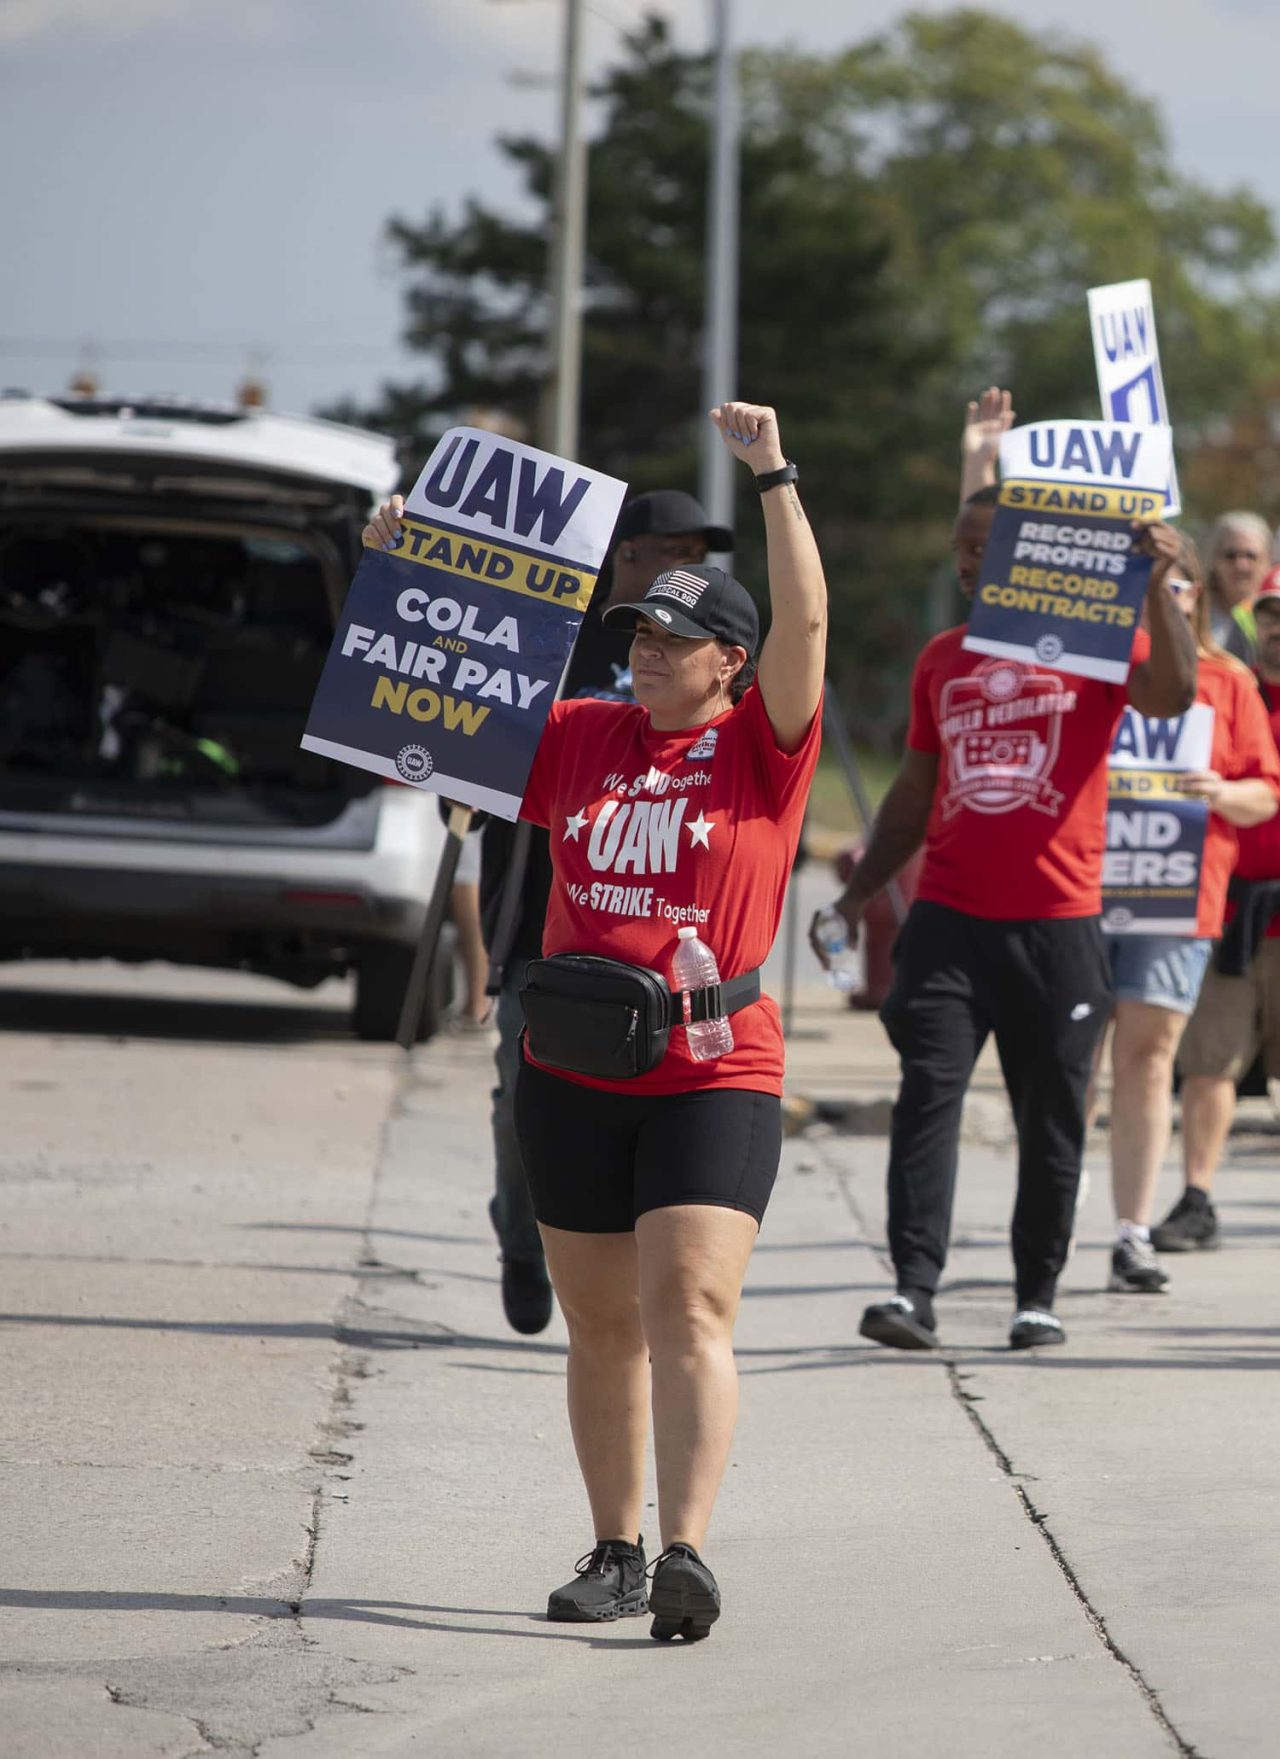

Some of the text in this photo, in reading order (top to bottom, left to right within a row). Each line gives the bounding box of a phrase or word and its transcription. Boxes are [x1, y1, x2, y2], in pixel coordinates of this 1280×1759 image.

[1029, 428, 1142, 478] UAW
[424, 435, 591, 546] UAW
[1010, 485, 1155, 516] STAND UP
[1019, 521, 1132, 551] RECORD
[1014, 541, 1126, 575] PROFITS
[524, 559, 581, 597] UP
[657, 586, 697, 606] LOCAL 900
[1009, 564, 1119, 600] RECORD
[396, 588, 520, 653] COLA
[980, 583, 1135, 627] CONTRACTS
[433, 635, 468, 654] AND
[341, 624, 550, 710] FAIR PAY
[371, 676, 491, 737] NOW
[1111, 711, 1185, 762] AW
[406, 756, 423, 769] UAW
[603, 773, 627, 795] We
[672, 770, 712, 791] ogethe
[587, 798, 688, 875] UAW
[1107, 810, 1182, 849] ND
[1103, 851, 1198, 887] ERS
[567, 881, 711, 925] We STRIKE Together
